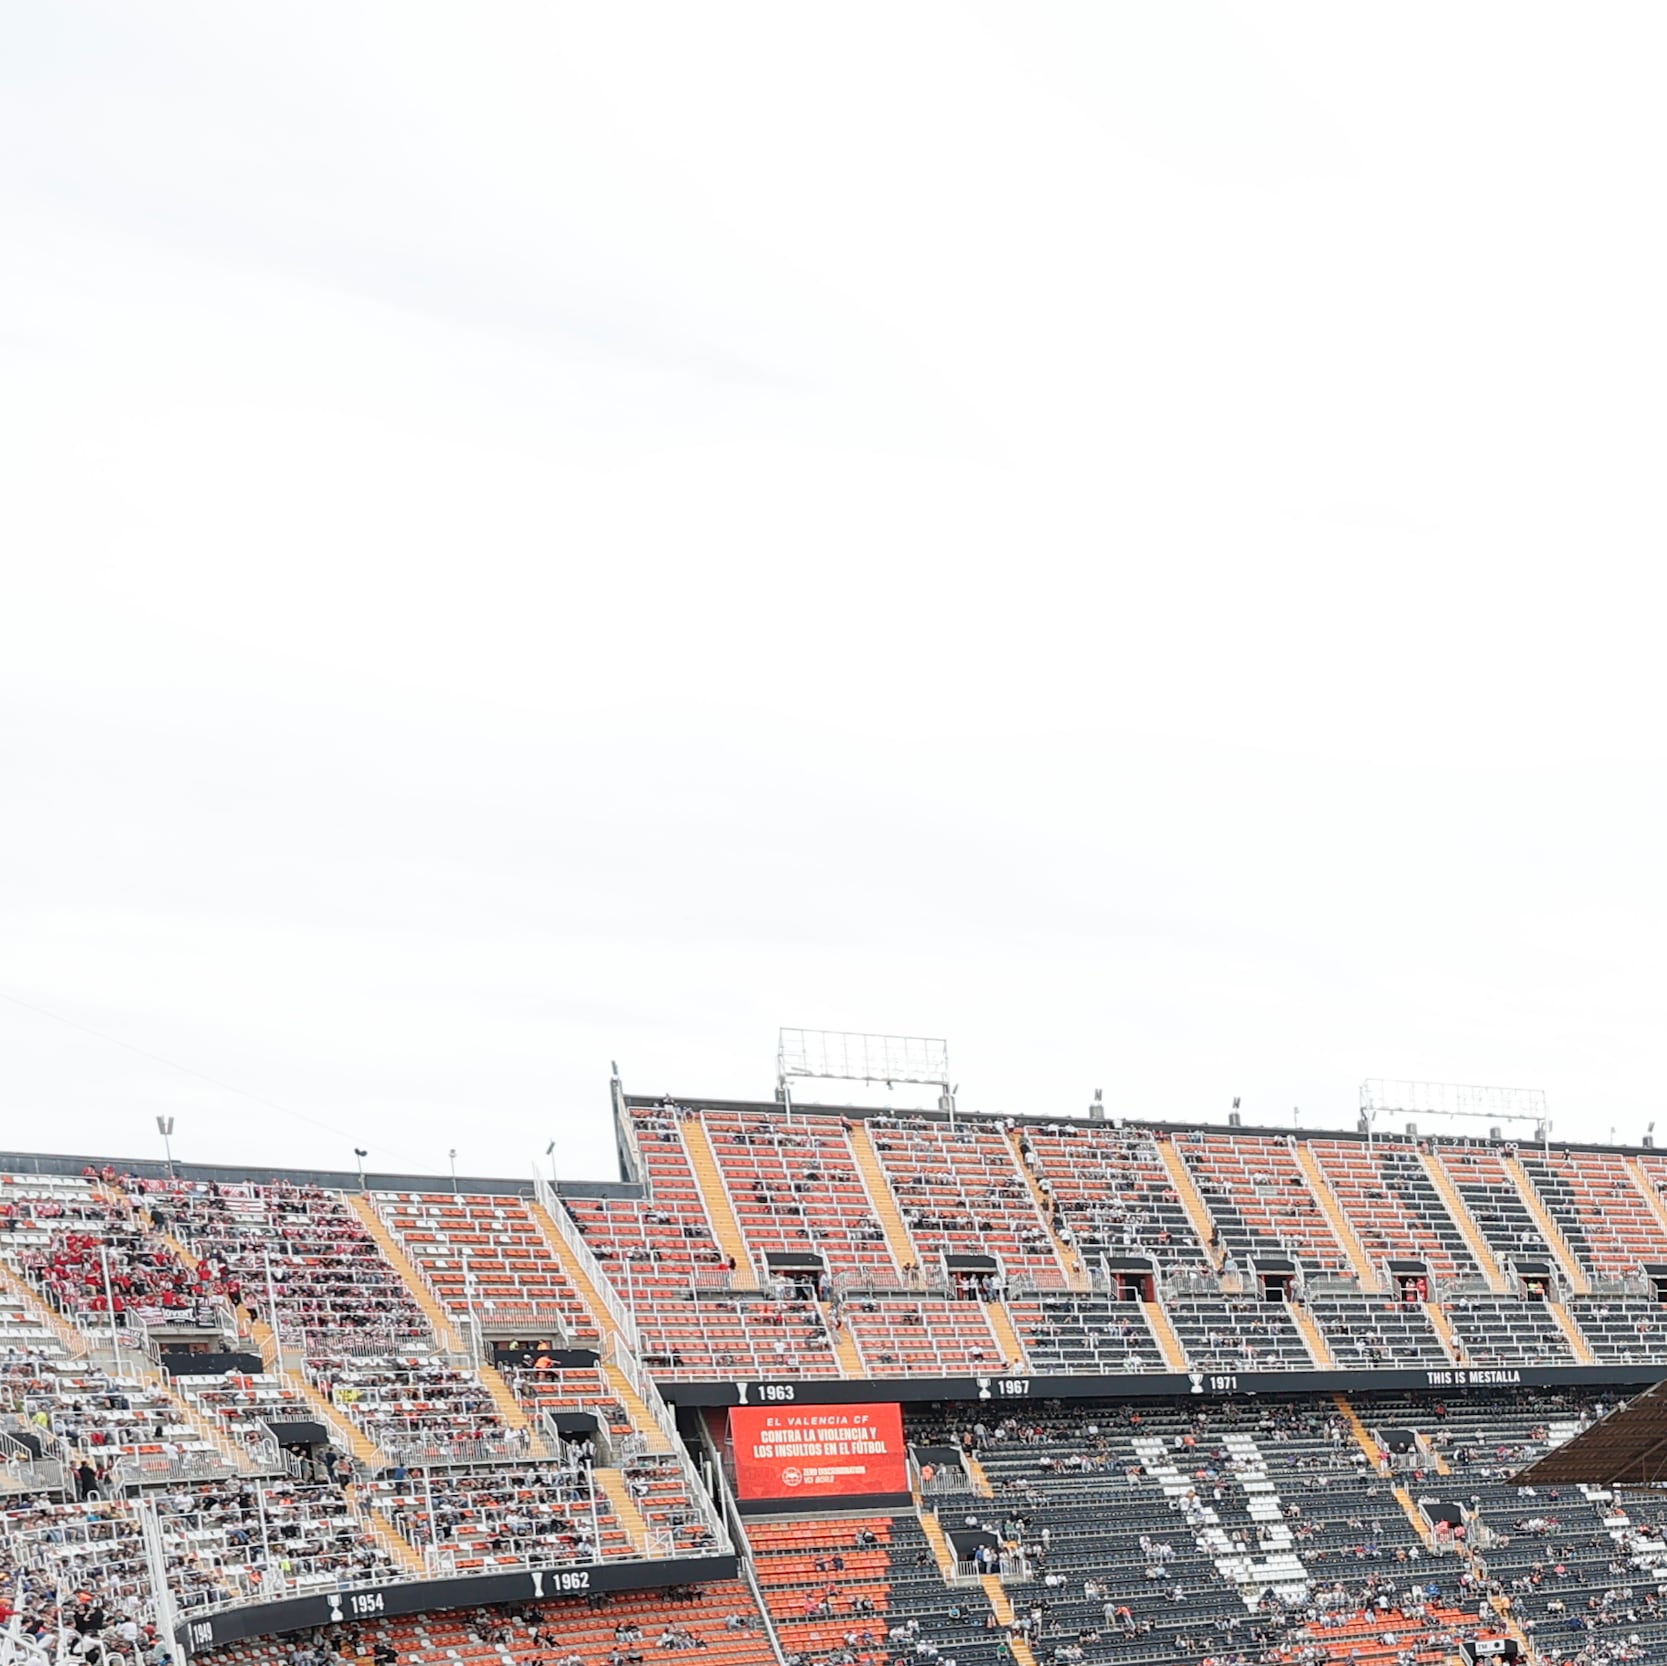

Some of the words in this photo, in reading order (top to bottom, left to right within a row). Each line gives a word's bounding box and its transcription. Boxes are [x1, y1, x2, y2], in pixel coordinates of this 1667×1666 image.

[1210, 1375, 1237, 1391] 1971
[1428, 1372, 1449, 1385] THIS
[1455, 1372, 1466, 1384] IS
[1469, 1370, 1520, 1384] MESTALLA
[758, 1386, 794, 1400] 1963
[998, 1378, 1030, 1396] 1967
[766, 1418, 782, 1426] EL
[787, 1416, 848, 1426] VALENCIA
[854, 1416, 869, 1424] CF
[761, 1429, 800, 1444] CONTRA
[804, 1428, 816, 1442] LA
[818, 1428, 868, 1441] VIOLENCIA
[870, 1428, 877, 1440] Y
[754, 1445, 772, 1458] LOS
[775, 1443, 822, 1457] INSULTOS
[824, 1443, 837, 1456] EN
[840, 1442, 850, 1454] EL
[552, 1571, 591, 1591] 1962
[350, 1593, 384, 1614] 1954
